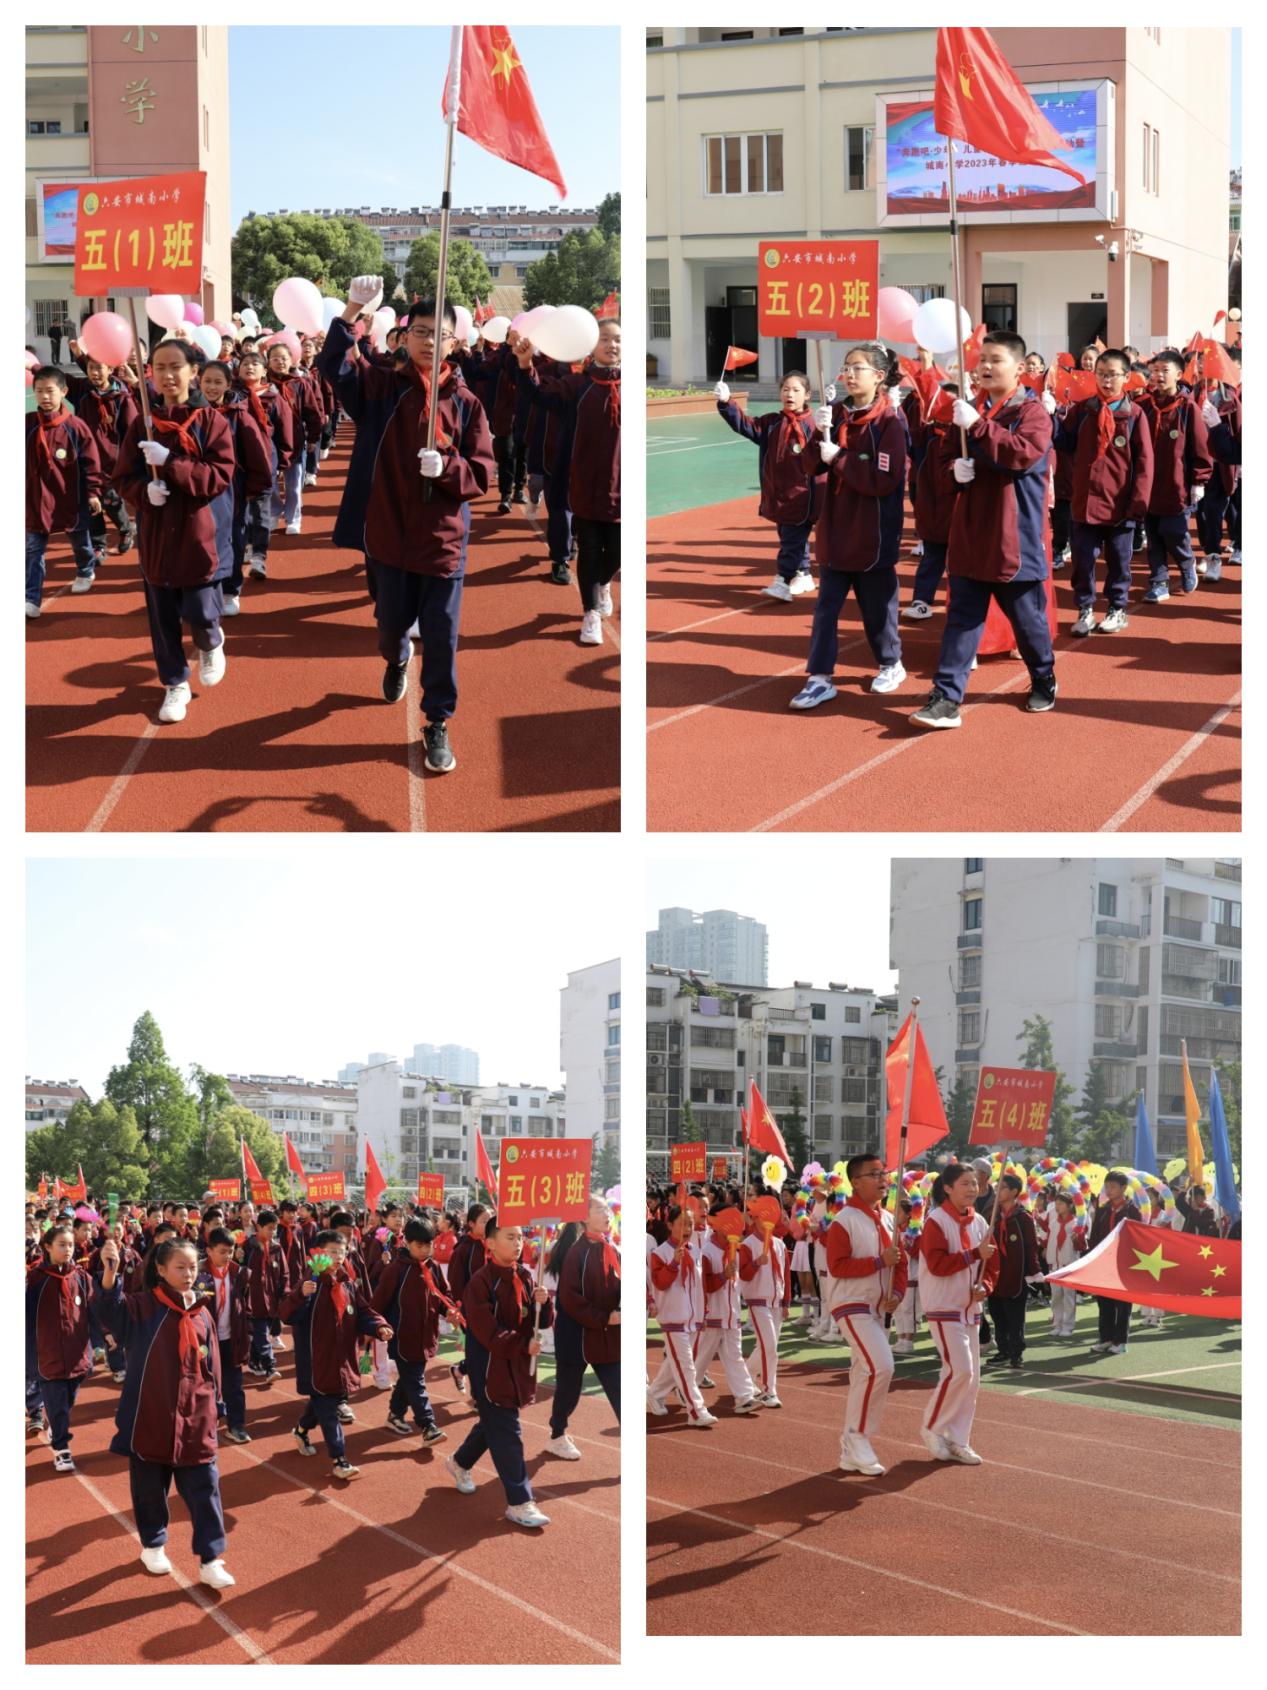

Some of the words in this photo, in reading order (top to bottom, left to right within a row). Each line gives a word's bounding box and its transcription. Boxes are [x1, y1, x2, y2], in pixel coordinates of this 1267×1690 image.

[121, 25, 159, 125] 小学
[101, 187, 181, 208] 六安市城南小学
[81, 220, 194, 272] 五(1)班
[782, 251, 857, 265] 六安市城南小学
[765, 279, 871, 319] 五(2)班
[977, 1099, 1048, 1131] 五(4)班
[504, 1171, 585, 1208] 五(3)班
